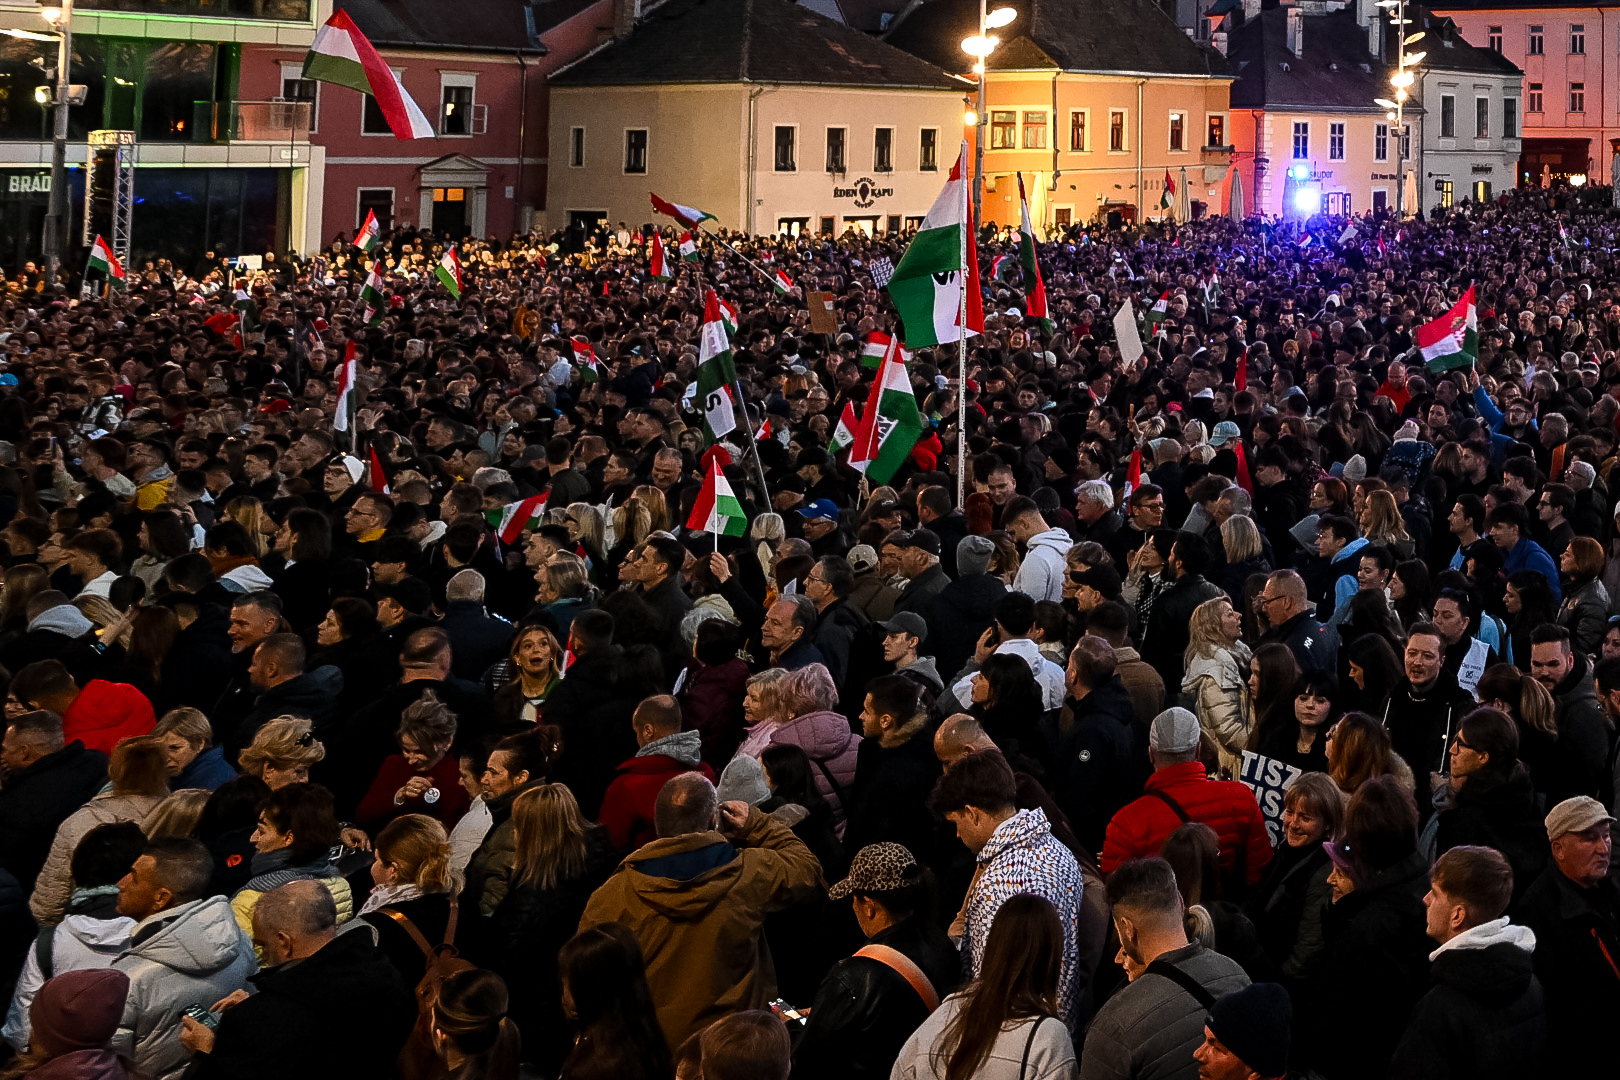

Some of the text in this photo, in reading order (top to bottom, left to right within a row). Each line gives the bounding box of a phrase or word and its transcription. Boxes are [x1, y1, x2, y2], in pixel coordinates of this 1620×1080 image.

[833, 187, 893, 198] ÉDEN KAPU
[876, 276, 892, 290] TIS
